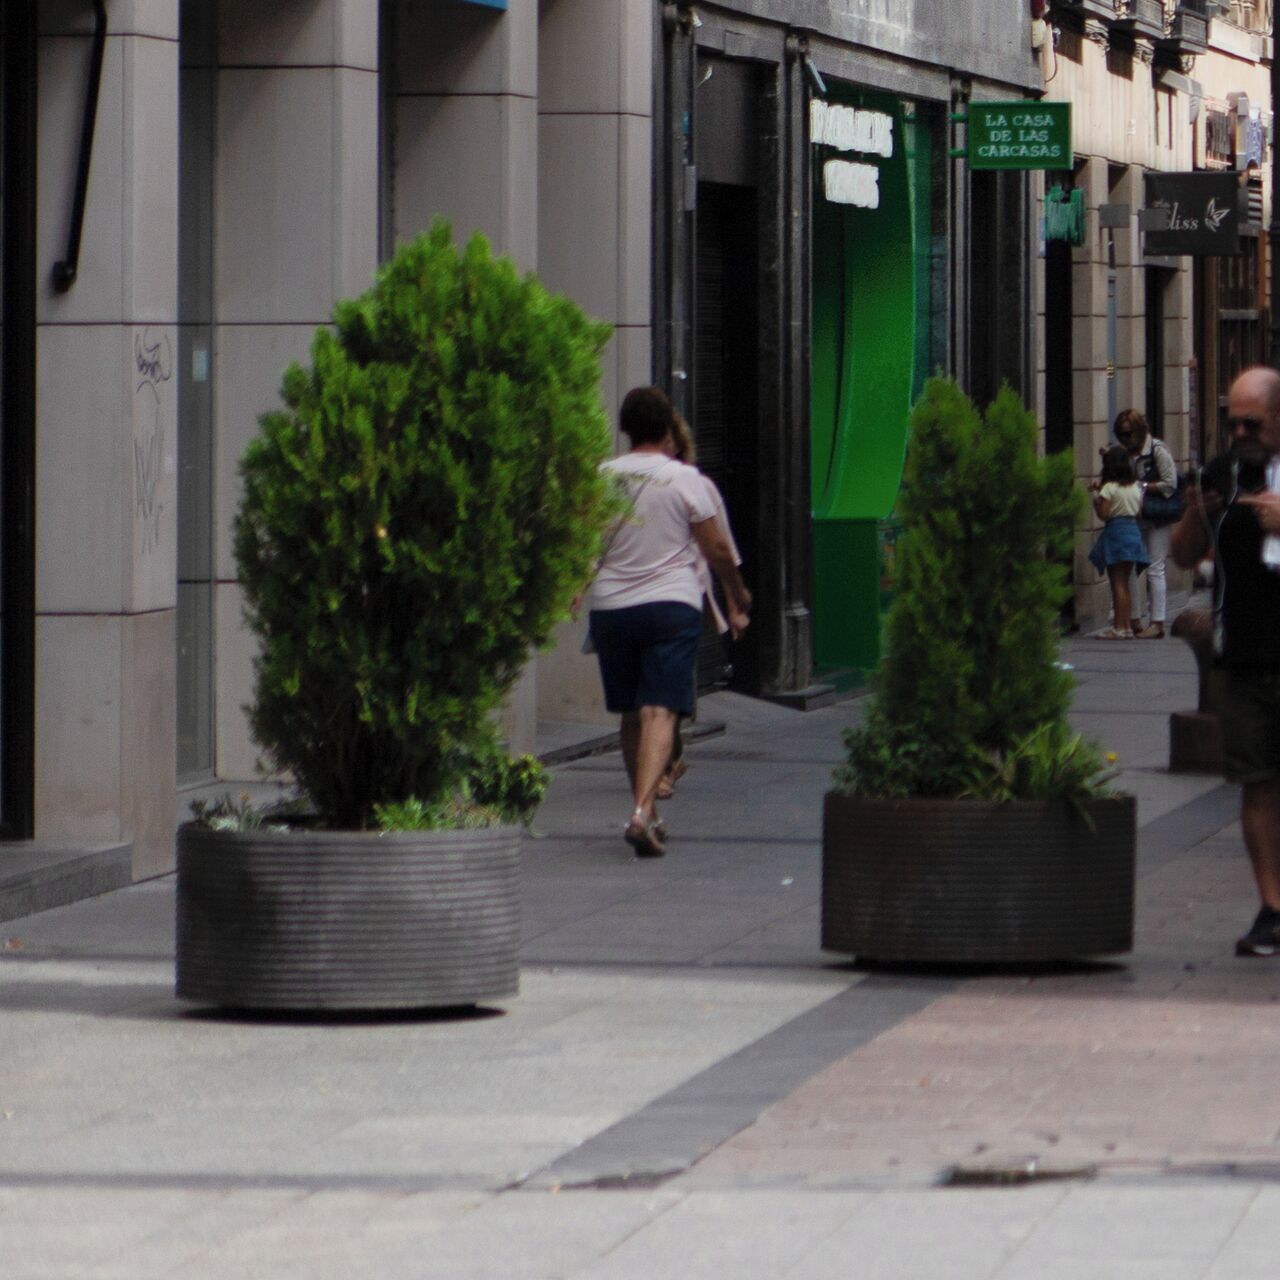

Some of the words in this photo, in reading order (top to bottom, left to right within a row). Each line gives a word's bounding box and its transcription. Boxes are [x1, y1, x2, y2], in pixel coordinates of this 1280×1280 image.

[985, 114, 1008, 127] LA
[1012, 114, 1055, 126] CASA
[989, 130, 1013, 142] DE
[1018, 130, 1049, 142] LAS
[978, 145, 1061, 158] CARCASAS
[1166, 200, 1199, 231] liss
